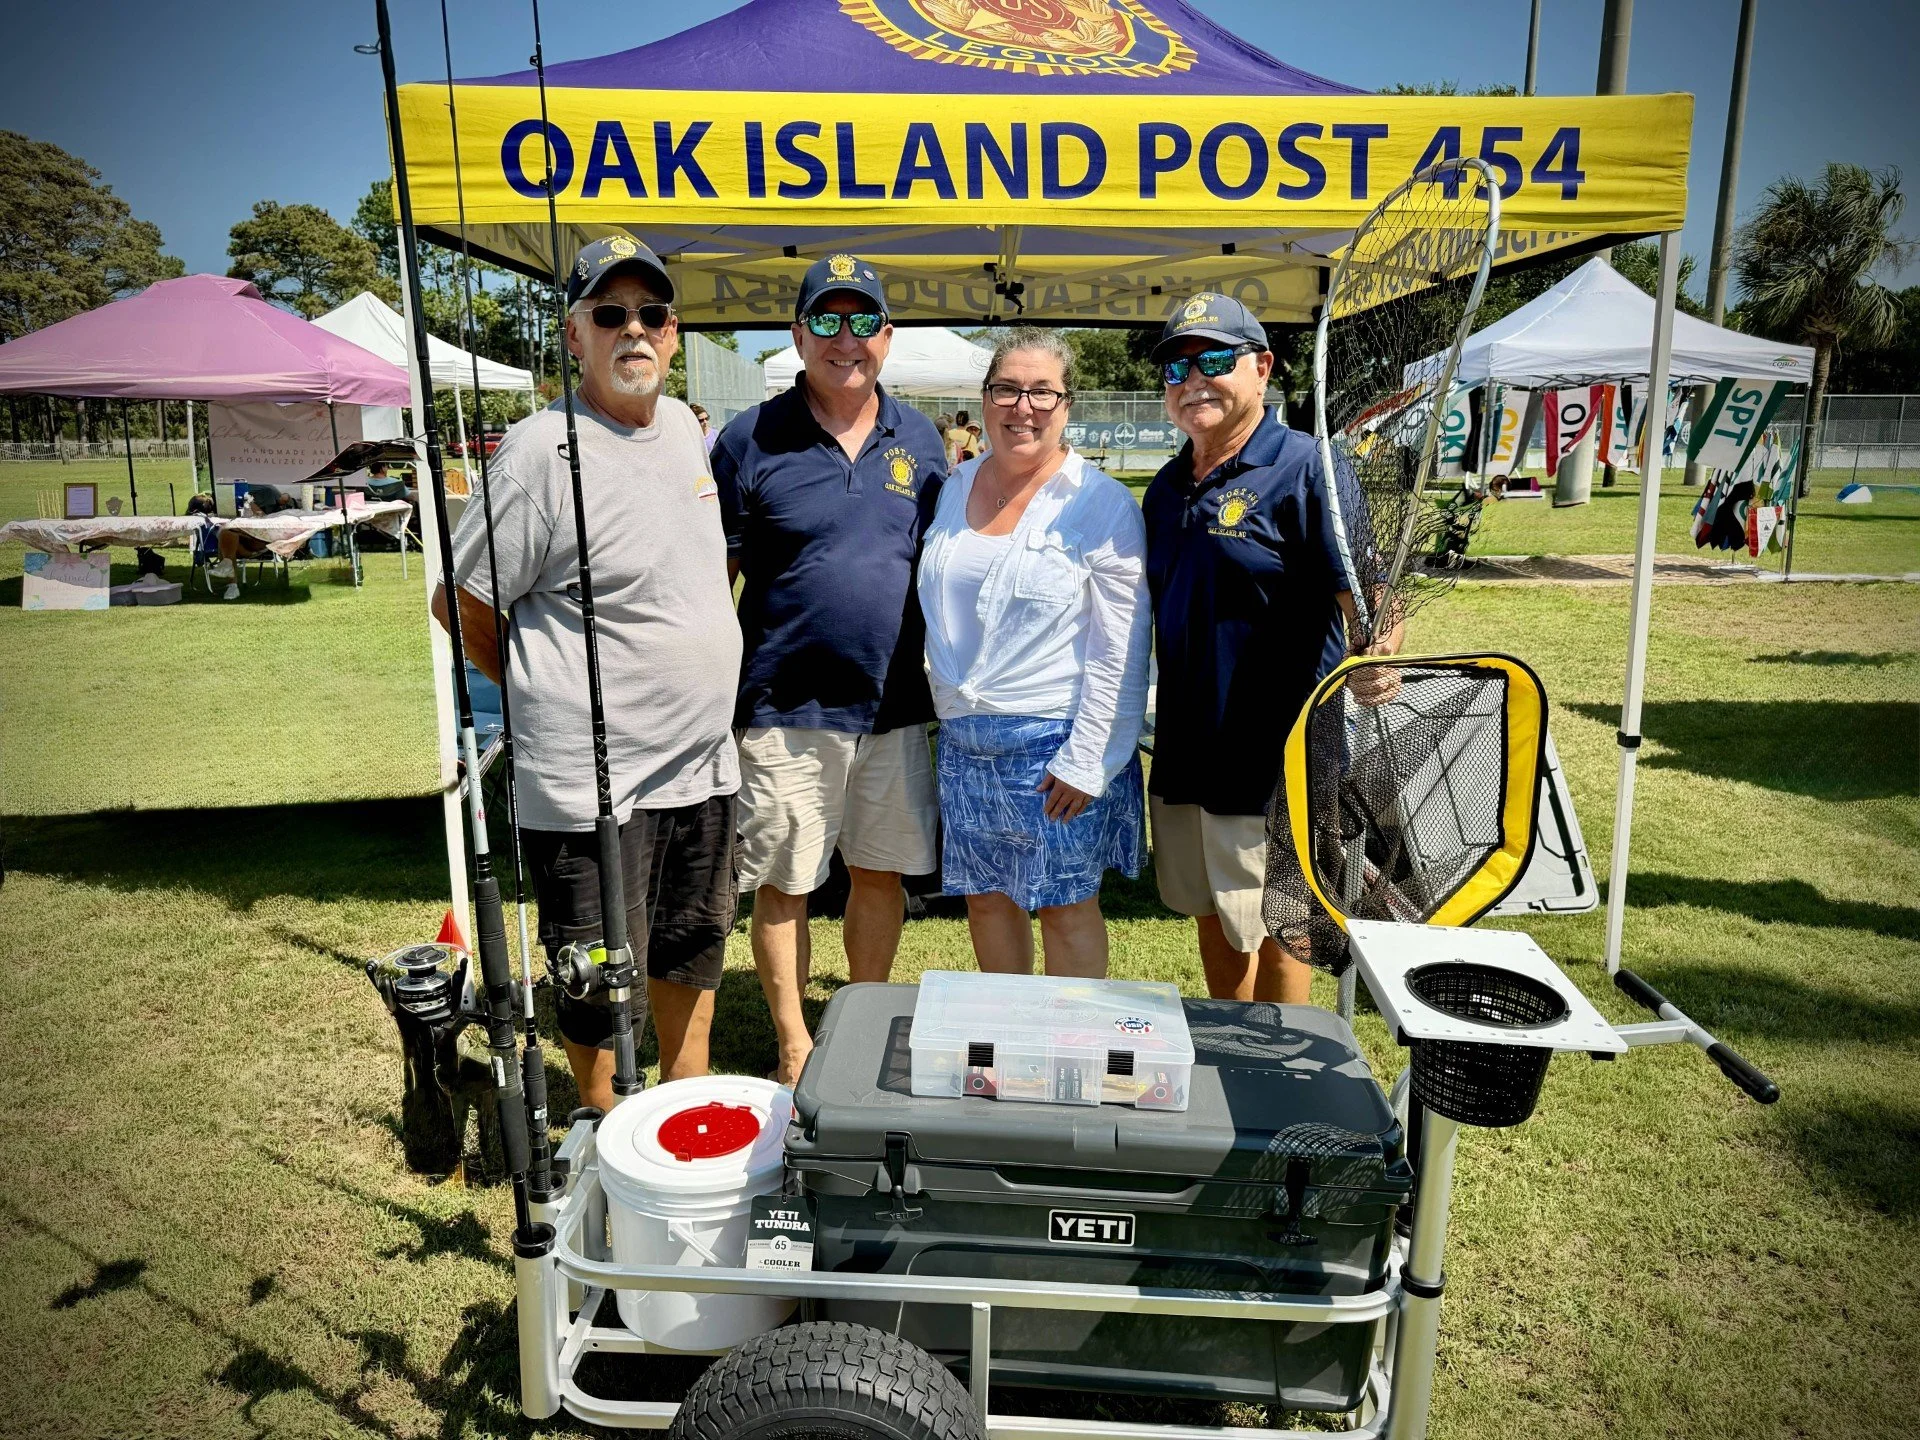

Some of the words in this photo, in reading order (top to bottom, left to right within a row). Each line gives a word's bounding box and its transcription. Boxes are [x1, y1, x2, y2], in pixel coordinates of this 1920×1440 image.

[500, 118, 720, 199] OAK
[744, 120, 1108, 200] ISLAND
[1138, 121, 1389, 201] POST
[1411, 125, 1587, 201] 454
[1713, 386, 1763, 447] SPT
[1440, 409, 1466, 463] OKI
[1492, 408, 1519, 462] OKI
[243, 447, 306, 456] HANDMADE
[883, 447, 906, 461] POST
[1217, 488, 1248, 503] POST
[768, 1209, 800, 1221] YETI
[889, 1212, 909, 1220] YETI
[754, 1219, 811, 1232] TUNDRA
[1054, 1216, 1128, 1241] YETI
[774, 1240, 787, 1250] 65
[763, 1259, 801, 1268] COOLER
